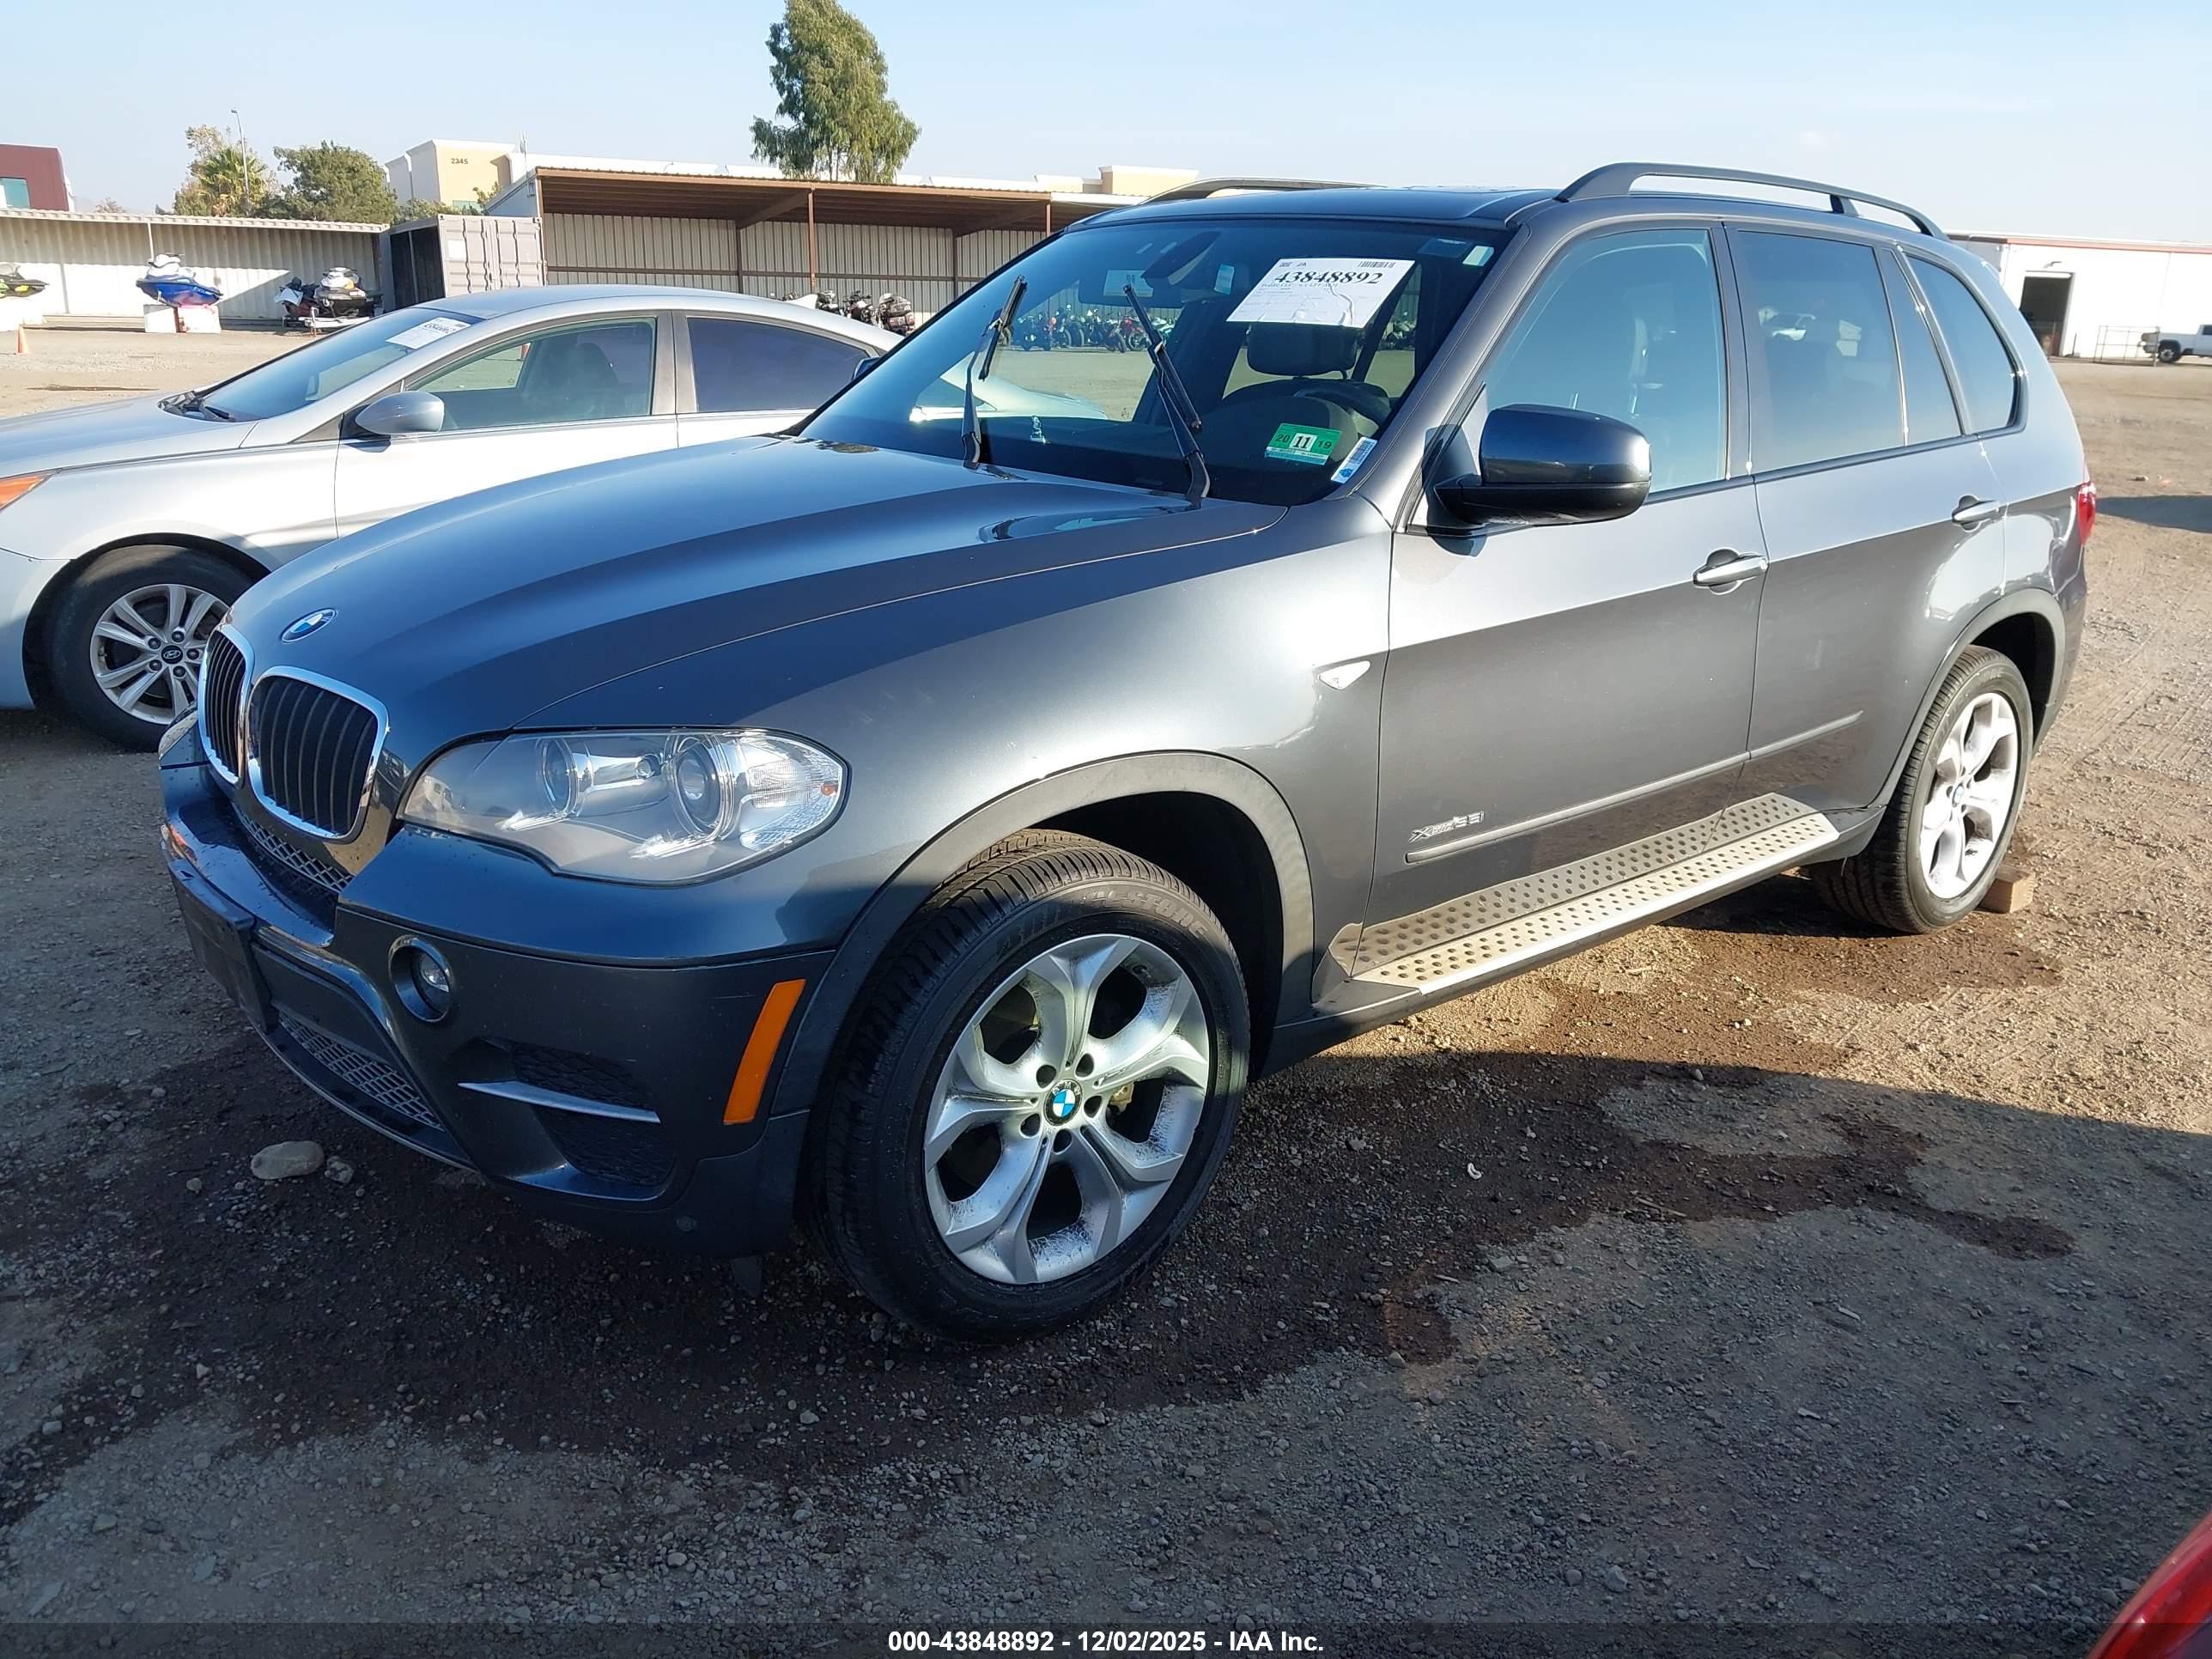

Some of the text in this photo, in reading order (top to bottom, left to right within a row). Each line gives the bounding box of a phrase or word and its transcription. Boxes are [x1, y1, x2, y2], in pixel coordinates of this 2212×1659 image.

[1274, 270, 1384, 284] 43848892
[1275, 434, 1333, 449] 20 11 19
